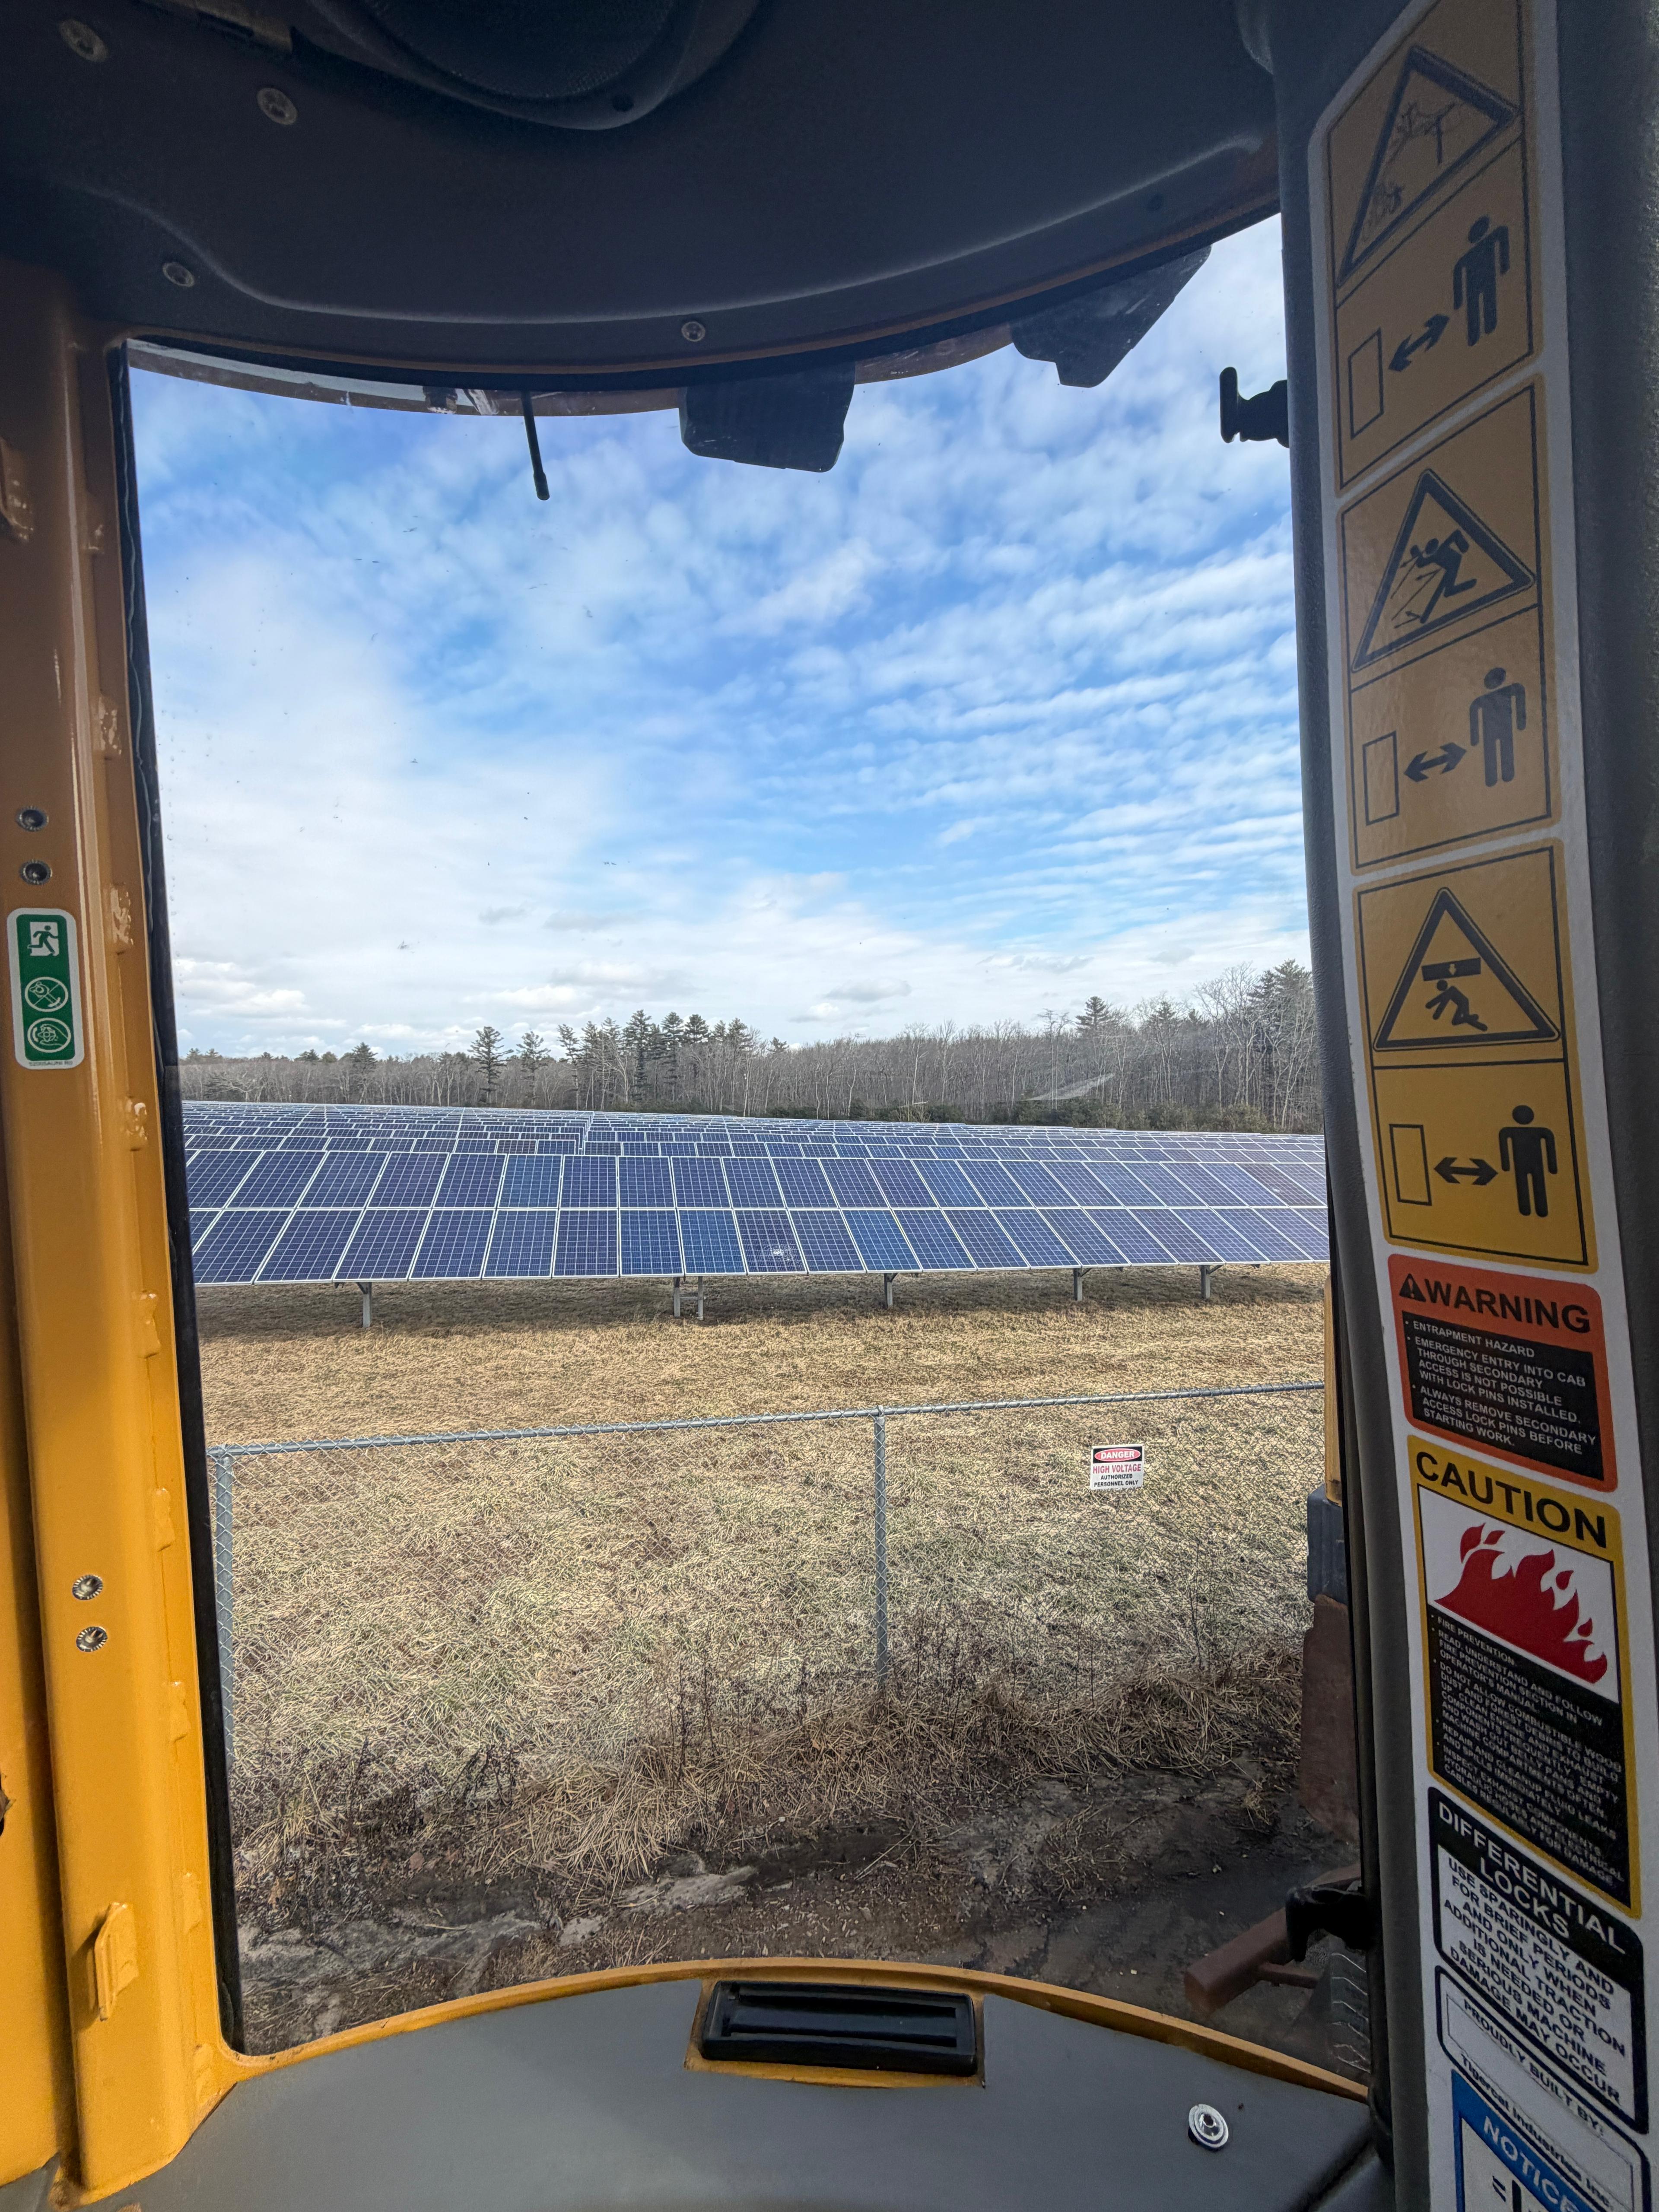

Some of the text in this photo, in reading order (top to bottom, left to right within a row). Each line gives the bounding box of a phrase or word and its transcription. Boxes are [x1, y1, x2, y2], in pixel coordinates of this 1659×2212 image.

[1424, 1278, 1590, 1333] WARNING
[1413, 1321, 1534, 1357] ENTRAPMENT HAZARD
[1414, 1336, 1586, 1386] EMERGENCY ENTRY INTO CAB
[1417, 1348, 1542, 1388] THROUGH SECONDARY
[1419, 1360, 1561, 1406] ACCESS IS NOT POSSIBLE
[1420, 1370, 1580, 1423] WITH LOCK PINS INSTALLED.
[1420, 1386, 1595, 1444] ALWAYS REMOVE SECONDARY
[1422, 1397, 1582, 1454] ACCESS LOCK PINS BEFORE
[1424, 1408, 1514, 1446] STARTING WORK.
[1093, 1464, 1141, 1474] HIGH VOLTAGE
[1101, 1451, 1135, 1459] DANGER
[1416, 1452, 1607, 1548] CAUTION
[1438, 1616, 1455, 1633] FIRE
[1439, 1639, 1577, 1723] FIRE PREVENTION SECTION IN
[1440, 1649, 1494, 1687] OPERATOR'S
[1465, 1645, 1528, 1686] UNDERSTAND
[1531, 1683, 1552, 1700] AND
[1555, 1695, 1602, 1726] FOLLOW
[1440, 1661, 1452, 1674] DO
[1454, 1670, 1471, 1686] NOT
[1473, 1683, 1505, 1707] ALLOW
[1508, 1703, 1580, 1751] COMBUSTIBLE
[1440, 1671, 1462, 1690] DUST
[1464, 1688, 1483, 1703] AND
[1485, 1698, 1521, 1726] FOREST
[1525, 1723, 1563, 1751] DEBRIS
[1567, 1747, 1580, 1761] TO
[1441, 1691, 1501, 1735] COMPONENTS
[1442, 1700, 1459, 1716] AND
[1461, 1713, 1487, 1735] WASH
[1489, 1731, 1507, 1748] OUT
[1442, 1710, 1480, 1741] MACHINE
[1458, 1693, 1487, 1716] CLEAN
[1490, 1712, 1524, 1739] ENGINE
[1528, 1736, 1549, 1753] AND
[1443, 1722, 1472, 1748] REPAIR
[1475, 1745, 1494, 1762] AND
[1443, 1733, 1460, 1749] AND
[1462, 1745, 1492, 1772] SPILLS
[1443, 1745, 1478, 1774] INSPECT
[1444, 1764, 1477, 1794] CABLES
[1439, 1802, 1624, 1953] DIFFERENTIAL
[1480, 1857, 1569, 1938] LOCKS
[1449, 1857, 1614, 1994] USE SPARINGLY AND
[1452, 1875, 1610, 2009] FOR BRIEF PERIODS
[1444, 1900, 1625, 2056] ADDITIONAL TRACTION
[1462, 1902, 1595, 2016] AND ONLY WHEN
[1459, 1941, 1605, 2075] SERIOUS MACHINE
[1473, 1938, 1584, 2041] IS NEEDED OR
[1450, 1946, 1619, 2104] DAMAGE MAY OCCUR
[1464, 1999, 1525, 2063] PROUDLY
[1529, 2063, 1572, 2106] BUILT
